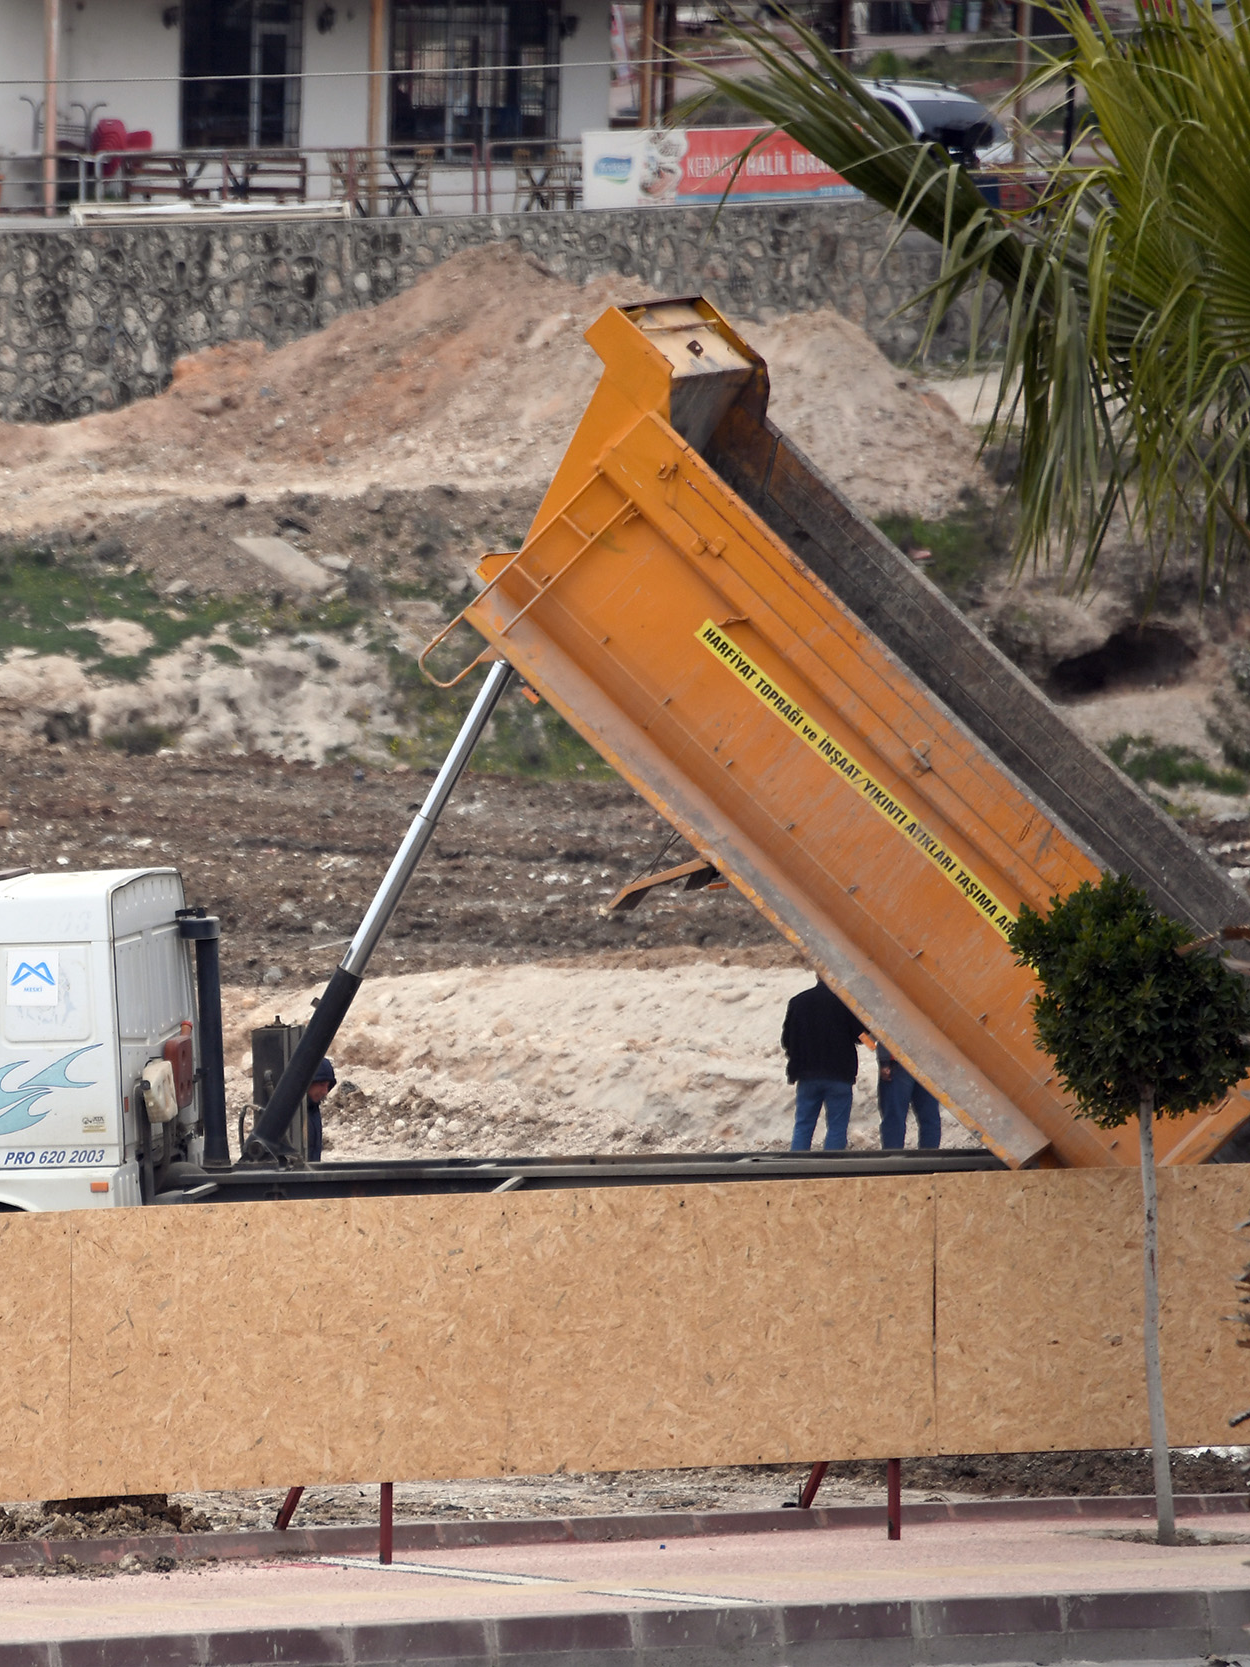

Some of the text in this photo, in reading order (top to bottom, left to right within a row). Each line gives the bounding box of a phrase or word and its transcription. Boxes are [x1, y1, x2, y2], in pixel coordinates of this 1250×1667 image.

[746, 151, 788, 176] HALİL
[702, 627, 757, 681] HARFİYAT
[754, 677, 804, 727] TOPRAĞI
[802, 725, 818, 742] ve
[905, 822, 957, 873] ATIKLARI
[954, 870, 998, 917] TAŞIMA
[4, 1149, 106, 1165] PRO 620 2003
